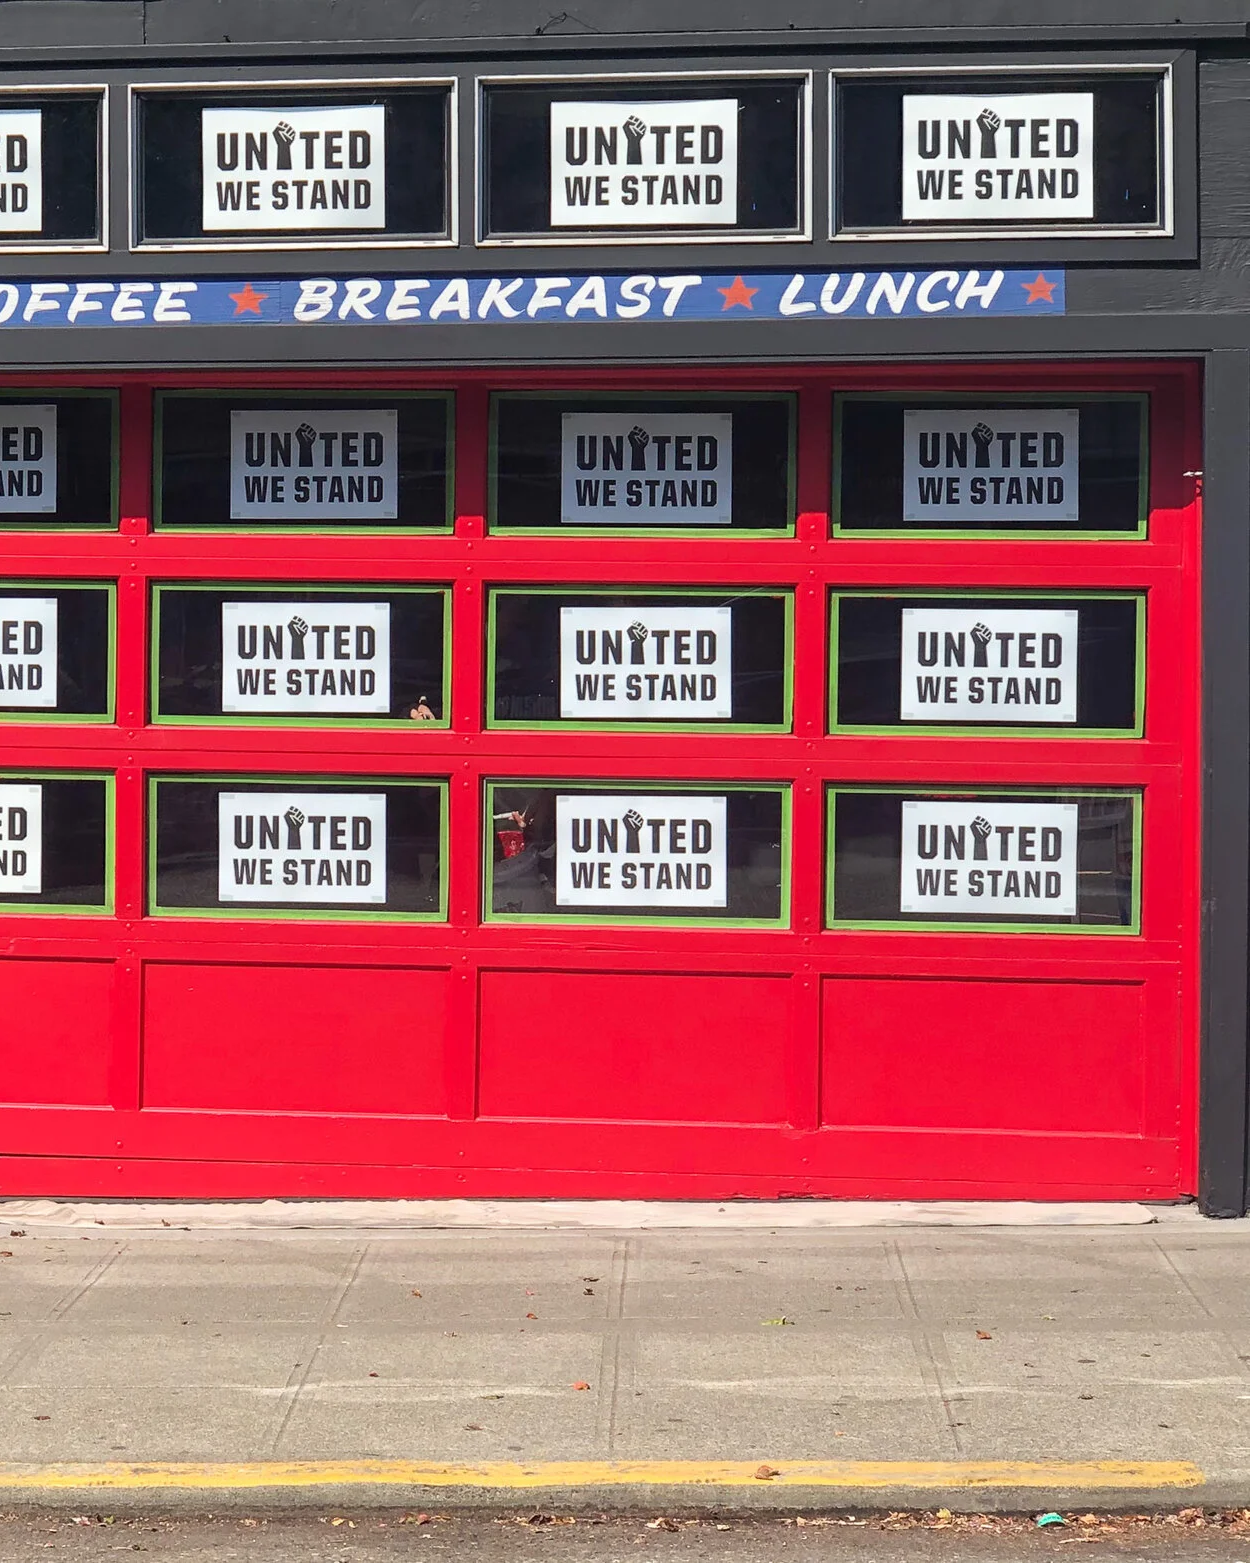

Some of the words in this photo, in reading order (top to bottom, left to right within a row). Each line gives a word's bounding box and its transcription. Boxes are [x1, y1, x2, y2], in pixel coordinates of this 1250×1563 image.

[217, 181, 260, 211] WE
[272, 180, 371, 210] STAND
[565, 176, 609, 206] WE
[622, 175, 722, 205] STAND
[917, 170, 963, 200] WE
[975, 169, 1078, 199] STAND
[293, 275, 703, 322] BREAKFAST
[778, 270, 1005, 316] LUNCH
[245, 476, 284, 502] WE
[295, 476, 383, 502] STAND
[576, 480, 616, 506] WE
[627, 480, 717, 506] STAND
[918, 477, 960, 504] WE
[971, 477, 1063, 504] STAND
[237, 669, 276, 695] WE
[287, 669, 375, 695] STAND
[576, 674, 615, 700] WE
[626, 674, 716, 701] STAND
[917, 676, 957, 703] WE
[969, 677, 1061, 704] STAND
[233, 859, 272, 885] WE
[283, 859, 371, 886] STAND
[571, 862, 610, 889] WE
[622, 863, 711, 889] STAND
[917, 869, 957, 896] WE
[969, 870, 1061, 898] STAND
